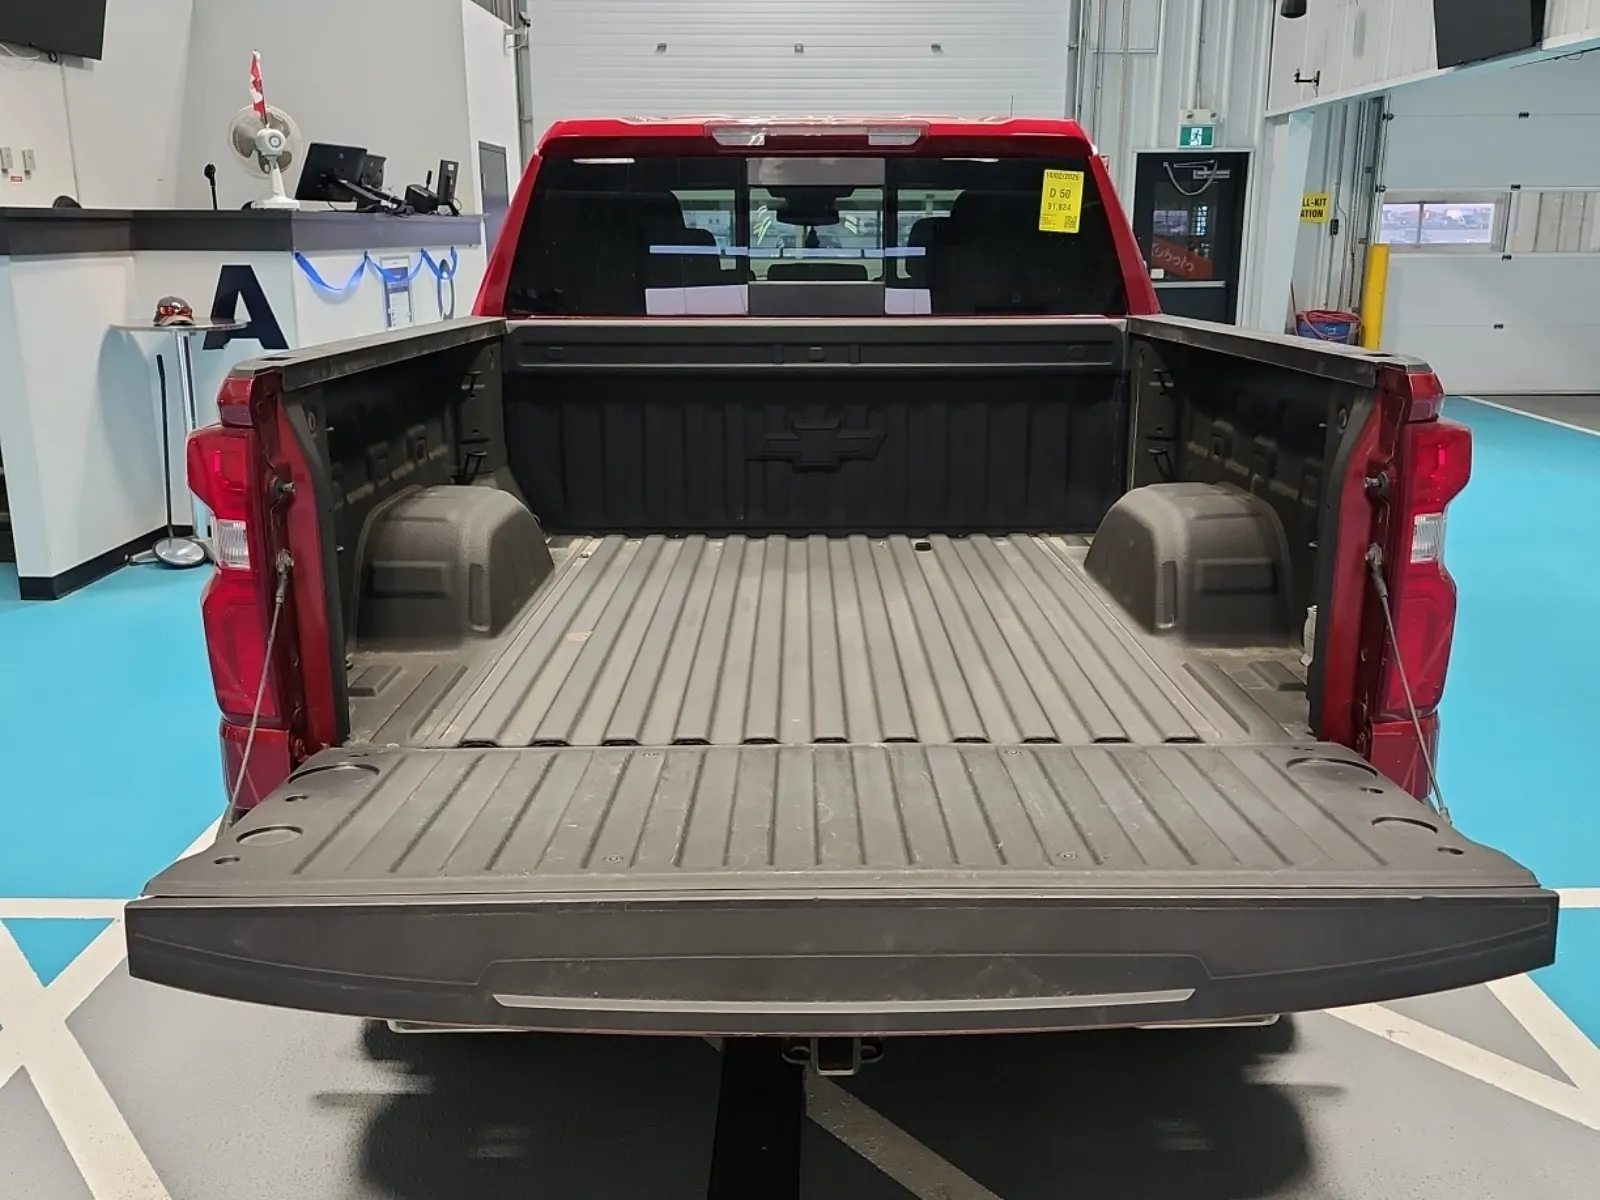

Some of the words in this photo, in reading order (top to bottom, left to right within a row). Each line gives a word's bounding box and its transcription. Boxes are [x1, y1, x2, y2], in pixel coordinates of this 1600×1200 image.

[1050, 187, 1056, 198] D
[1059, 188, 1071, 199] 50
[203, 265, 290, 350] A
